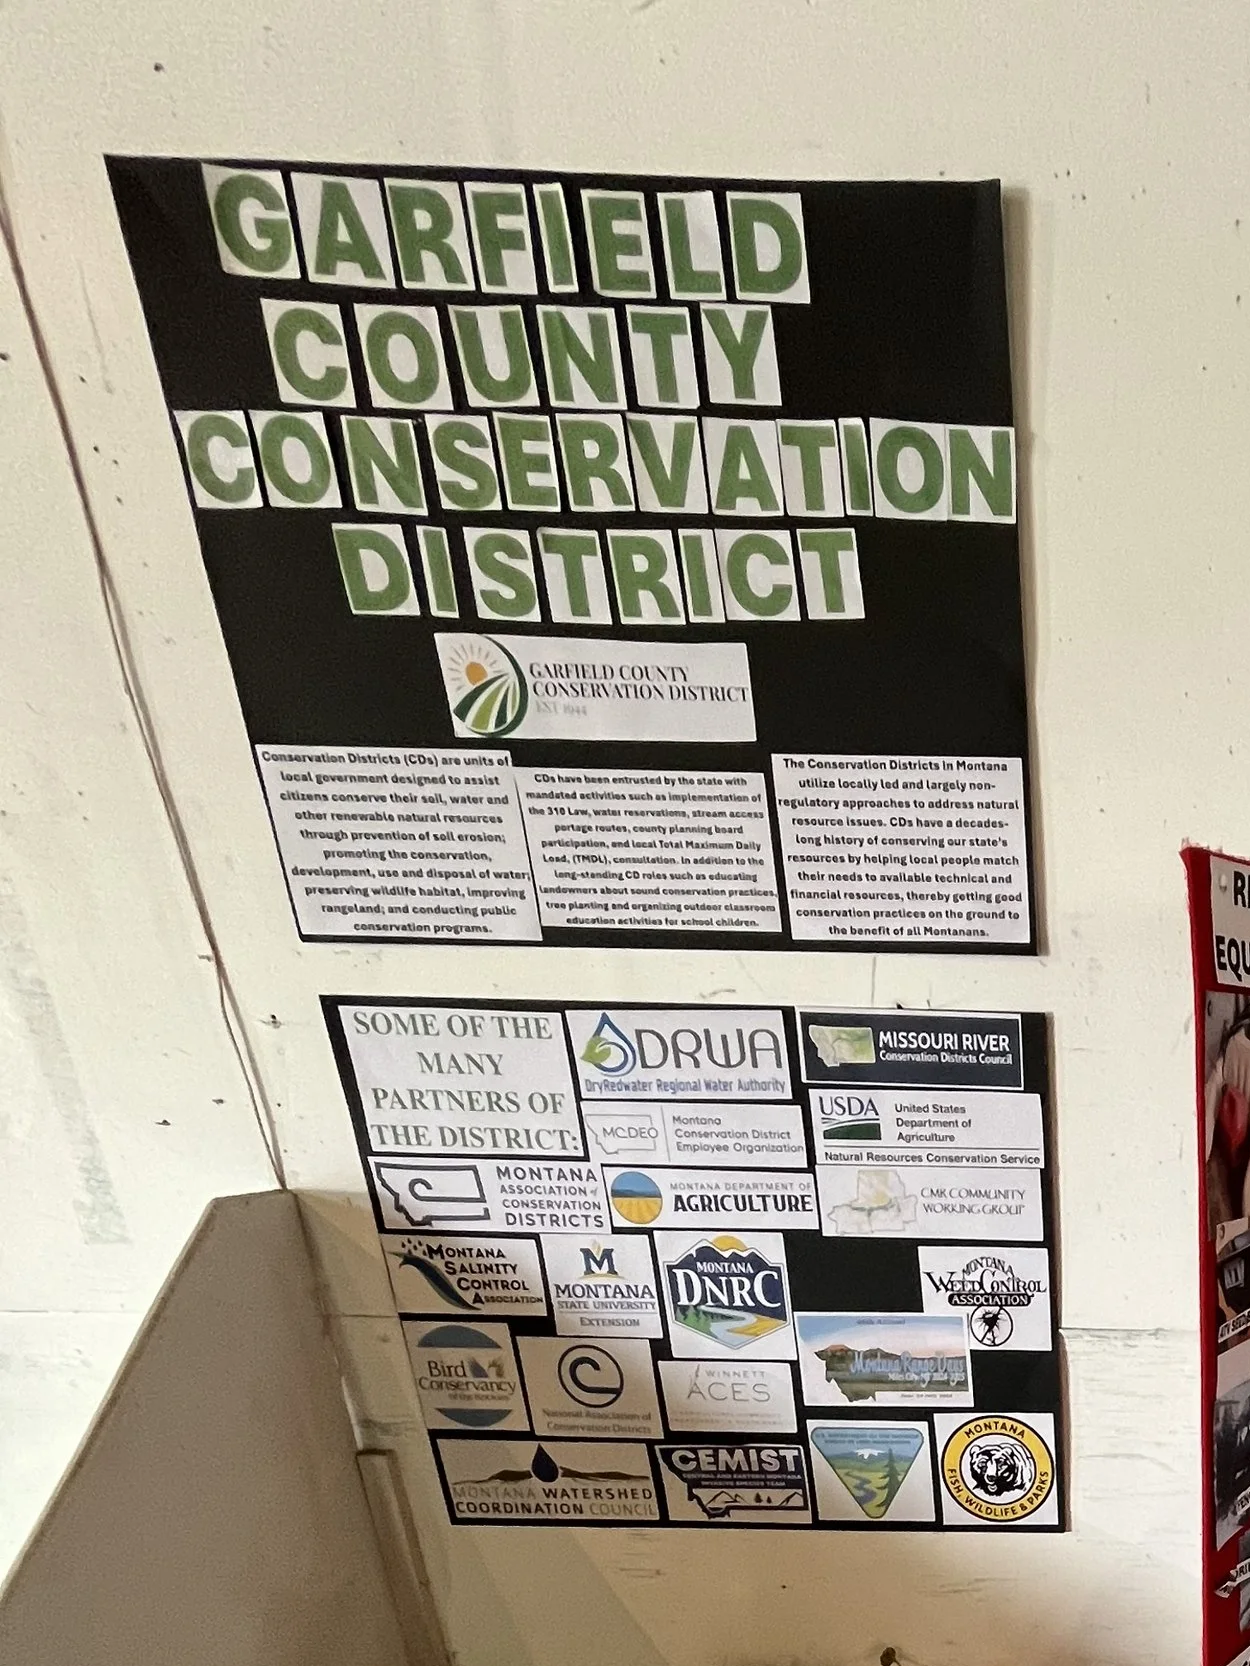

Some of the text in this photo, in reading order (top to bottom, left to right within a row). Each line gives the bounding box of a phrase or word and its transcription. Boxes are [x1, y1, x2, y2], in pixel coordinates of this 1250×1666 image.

[212, 173, 802, 295] GARFIELD
[272, 307, 770, 404] COUNTY
[187, 414, 1012, 517] CONSERVATION
[333, 527, 858, 615] DISTRICT
[529, 662, 689, 682] GARFIELD COUNTY
[532, 682, 749, 702] CONSERVATION DISTRICT
[262, 751, 509, 768] Conservation Districts (CDs) are units of
[783, 758, 805, 769] The
[807, 758, 887, 770] Conservation
[889, 759, 940, 771] Districts
[956, 761, 1008, 772] Montana
[534, 773, 747, 787] CDs have been entrusted by the state with
[799, 777, 996, 793] utilize locally led and largely non-
[353, 1011, 553, 1040] SOME OF THE
[635, 1028, 783, 1069] DRWA
[878, 1031, 1010, 1052] MISSOURI RIVER
[416, 1051, 503, 1076] MANY
[879, 1051, 1012, 1065] Conservation Districts Council
[585, 1078, 786, 1095] DryRedwater Regional Water Authority
[371, 1087, 565, 1115] PARTNERS OF
[818, 1096, 879, 1116] USDA
[894, 1103, 966, 1114] United States
[672, 1115, 721, 1125] Montana
[896, 1118, 972, 1129] Department of
[370, 1124, 579, 1151] THE DISTRICT:
[675, 1128, 791, 1140] Conservation District
[897, 1132, 955, 1143] Agriculture
[676, 1142, 804, 1155] Employee Organization
[825, 1152, 1040, 1165] Natural Resources Conservation Service
[496, 1165, 598, 1183] MONTANA
[499, 1184, 588, 1196] ASSOCIATION
[502, 1199, 601, 1211] CONSERVATION
[673, 1194, 814, 1213] AGRICULTURE
[505, 1213, 604, 1229] DISTRICTS
[426, 1243, 506, 1259] MONTANA
[444, 1261, 518, 1275] SALINITY
[696, 1261, 754, 1274] MONTANA
[457, 1277, 529, 1291] CONTROL
[554, 1283, 655, 1299] MONTANA
[672, 1268, 781, 1308] DNRC
[427, 1360, 466, 1378] Bird
[418, 1378, 516, 1395] Conservancy
[687, 1382, 771, 1402] ACES
[964, 1421, 1026, 1439] MONTANA
[671, 1448, 799, 1472] CEMIST
[452, 1486, 653, 1500] MONTANA WATERSHED
[947, 1468, 1049, 1516] FISH, WILDLIFE & PARKS
[456, 1501, 655, 1516] COORDINATION COUNCIL
